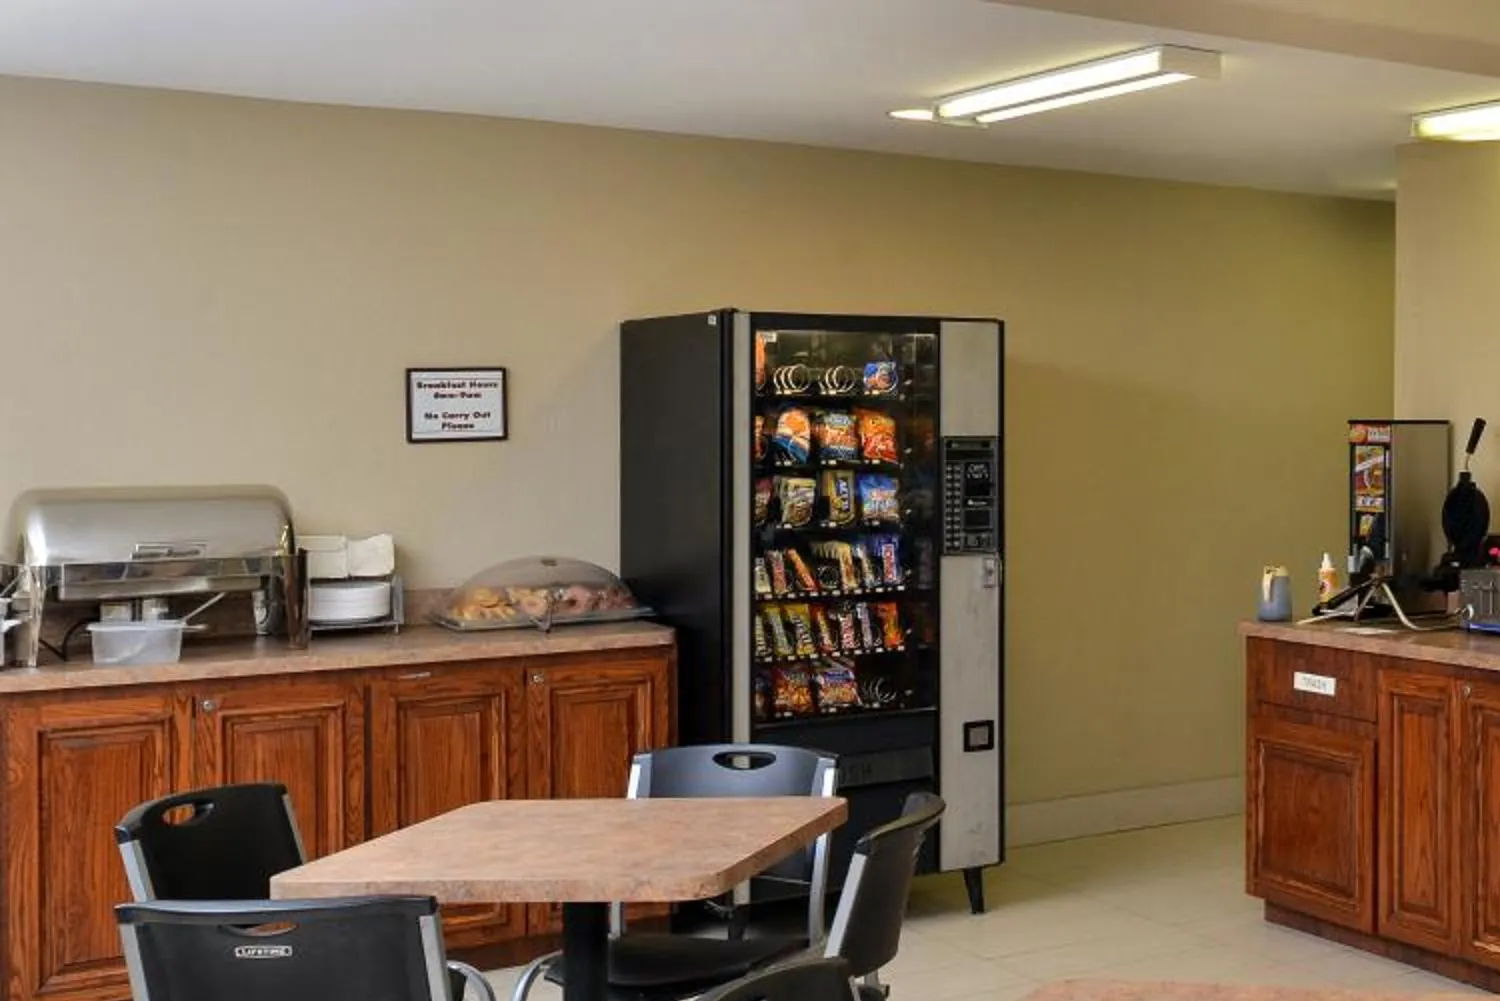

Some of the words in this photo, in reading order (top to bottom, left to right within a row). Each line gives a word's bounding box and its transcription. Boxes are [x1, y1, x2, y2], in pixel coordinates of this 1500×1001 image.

[416, 381, 467, 389] Breakfast
[469, 381, 498, 389] Hours
[442, 411, 470, 420] Carry
[473, 411, 491, 419] Out
[441, 422, 475, 430] Please
